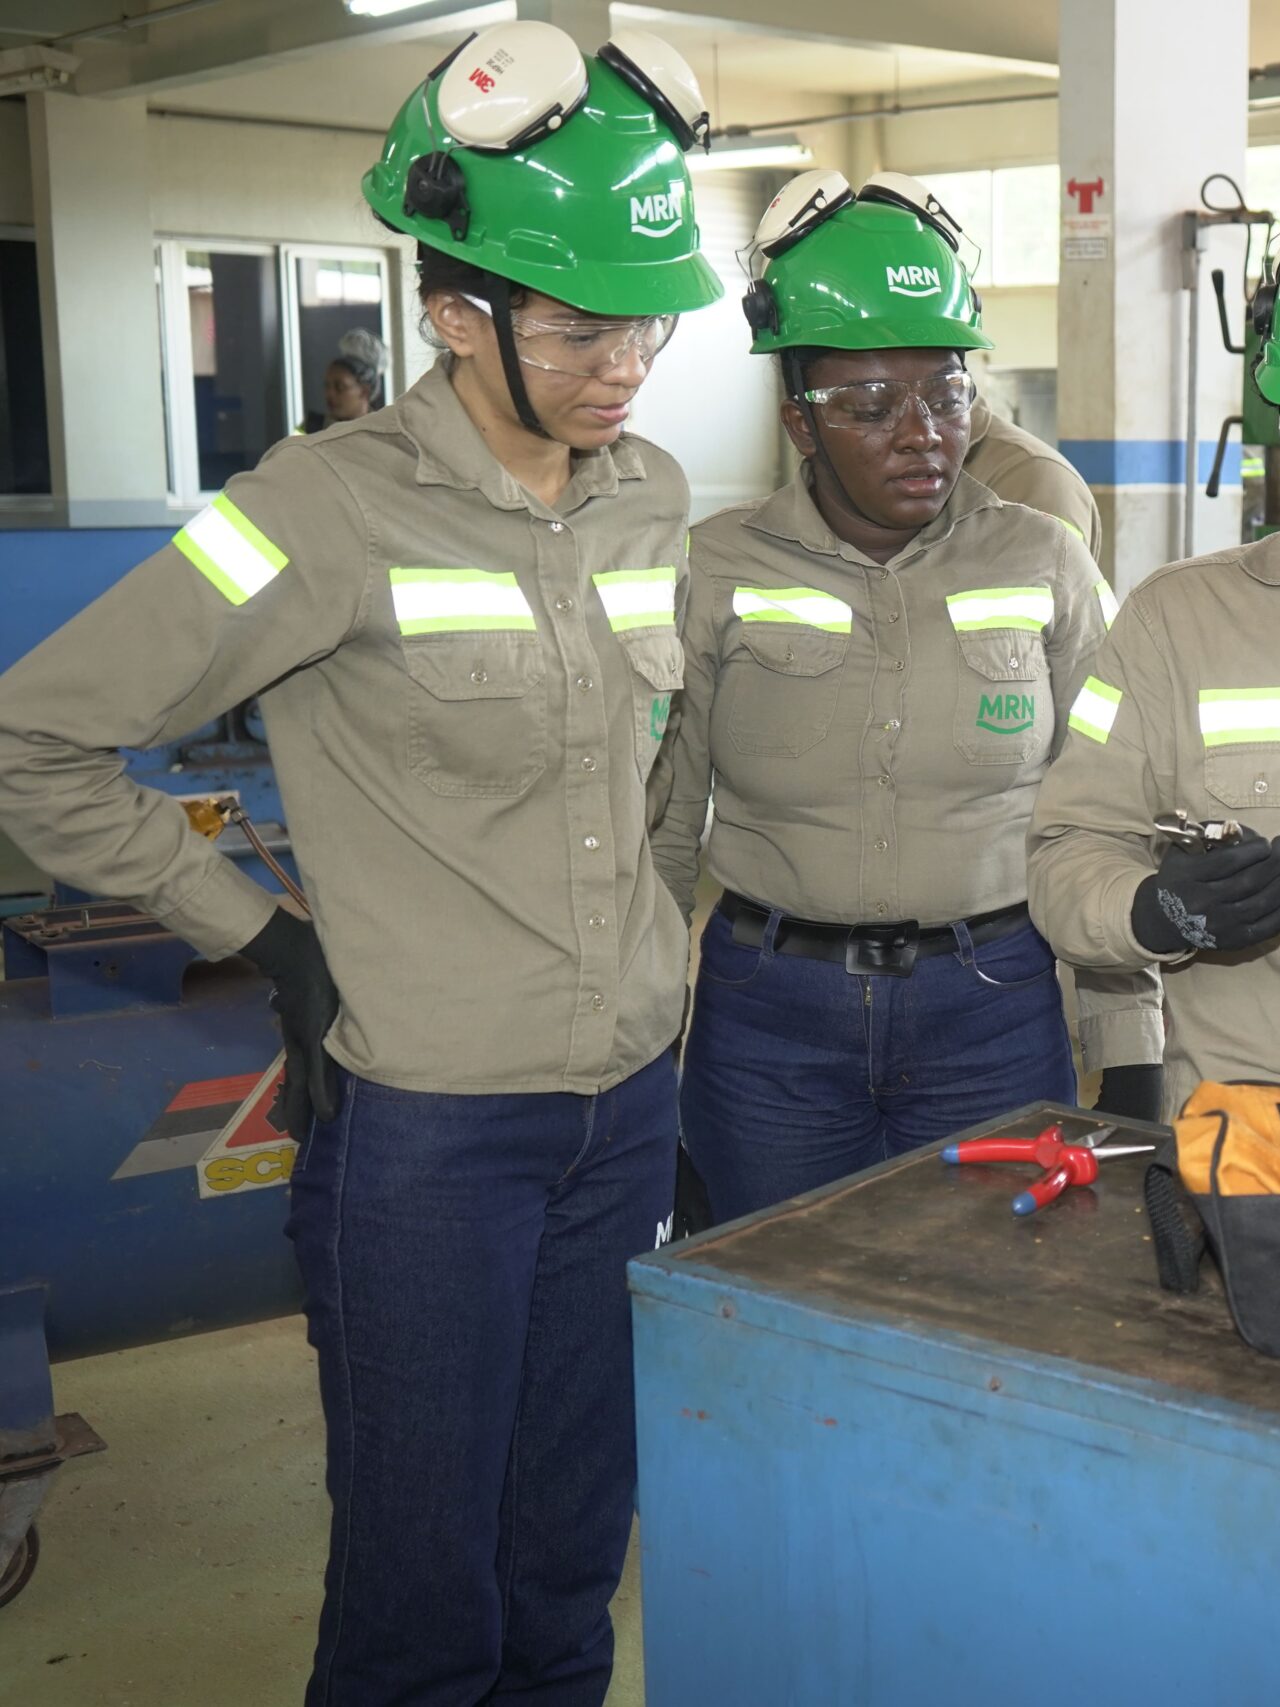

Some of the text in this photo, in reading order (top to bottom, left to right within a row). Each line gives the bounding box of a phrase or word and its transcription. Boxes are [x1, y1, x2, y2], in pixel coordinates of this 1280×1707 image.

[469, 67, 496, 94] 3M
[630, 192, 683, 225] MRN
[886, 265, 940, 287] MRN
[978, 694, 1035, 720] MRN
